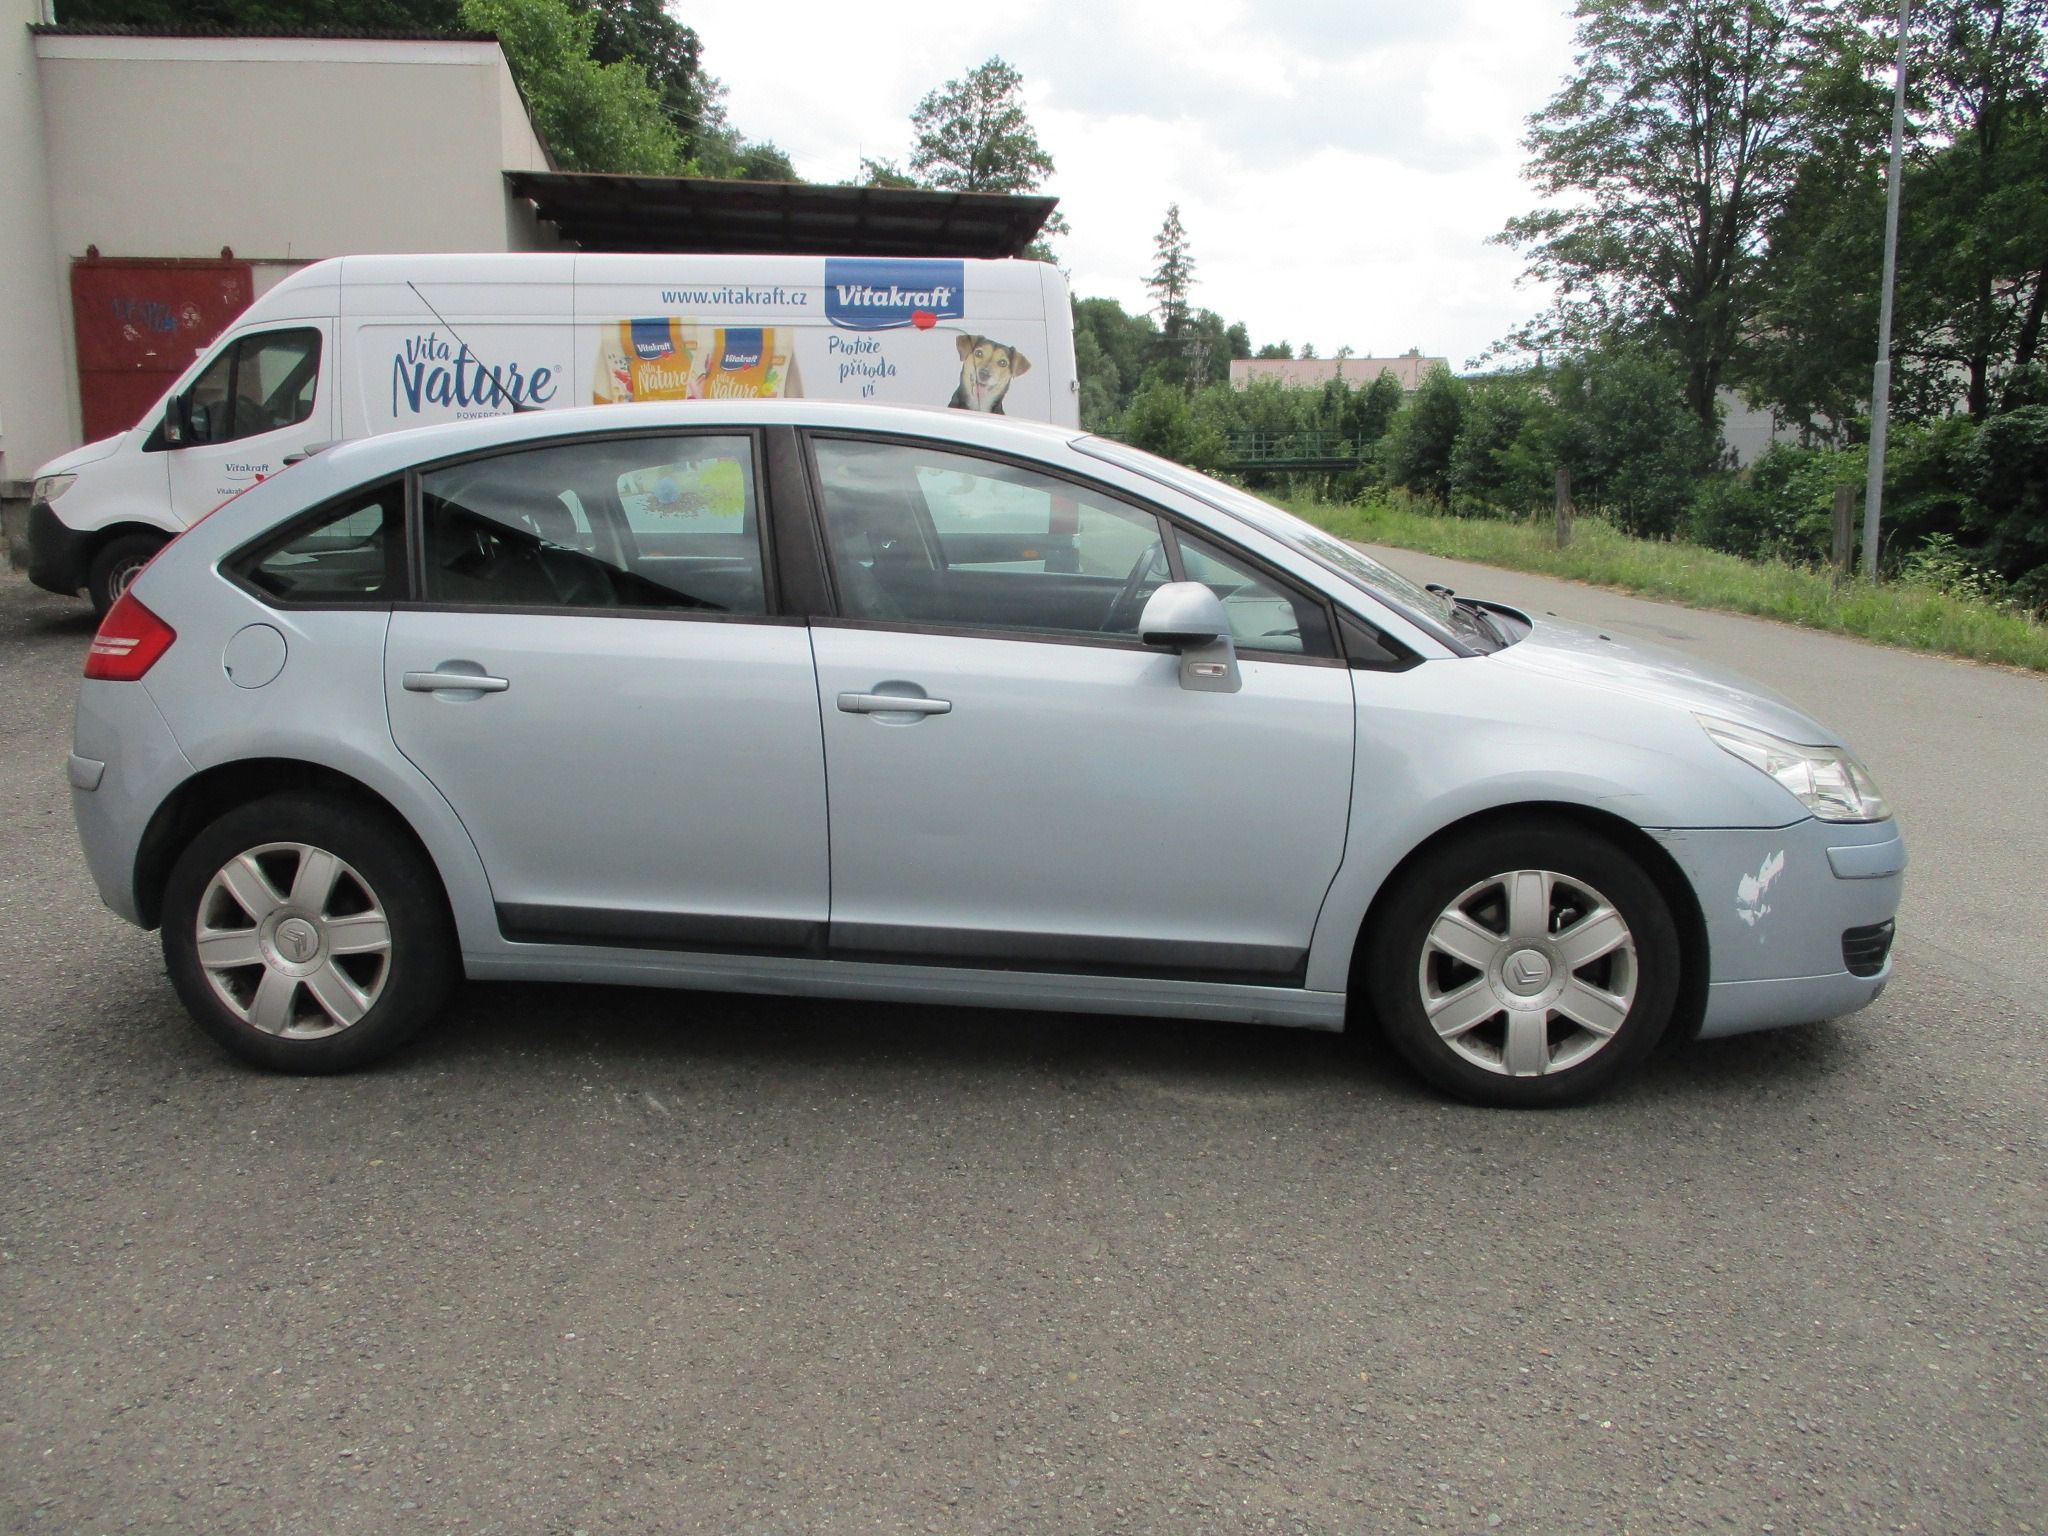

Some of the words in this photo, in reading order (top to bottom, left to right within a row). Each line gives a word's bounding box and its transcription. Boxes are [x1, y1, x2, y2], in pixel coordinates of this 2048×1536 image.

[661, 287, 808, 306] www.vitakraft.cz
[836, 284, 951, 307] Vitakraft
[405, 331, 451, 365] Vita
[636, 342, 671, 353] Vitakraft
[828, 335, 881, 356] Protože
[725, 354, 758, 363] Vitakraft
[638, 364, 688, 396] Nature
[839, 356, 897, 384] příroda
[392, 343, 558, 418] Nature
[709, 379, 759, 399] Nature
[862, 380, 876, 398] ví
[225, 463, 270, 472] Vitakraft
